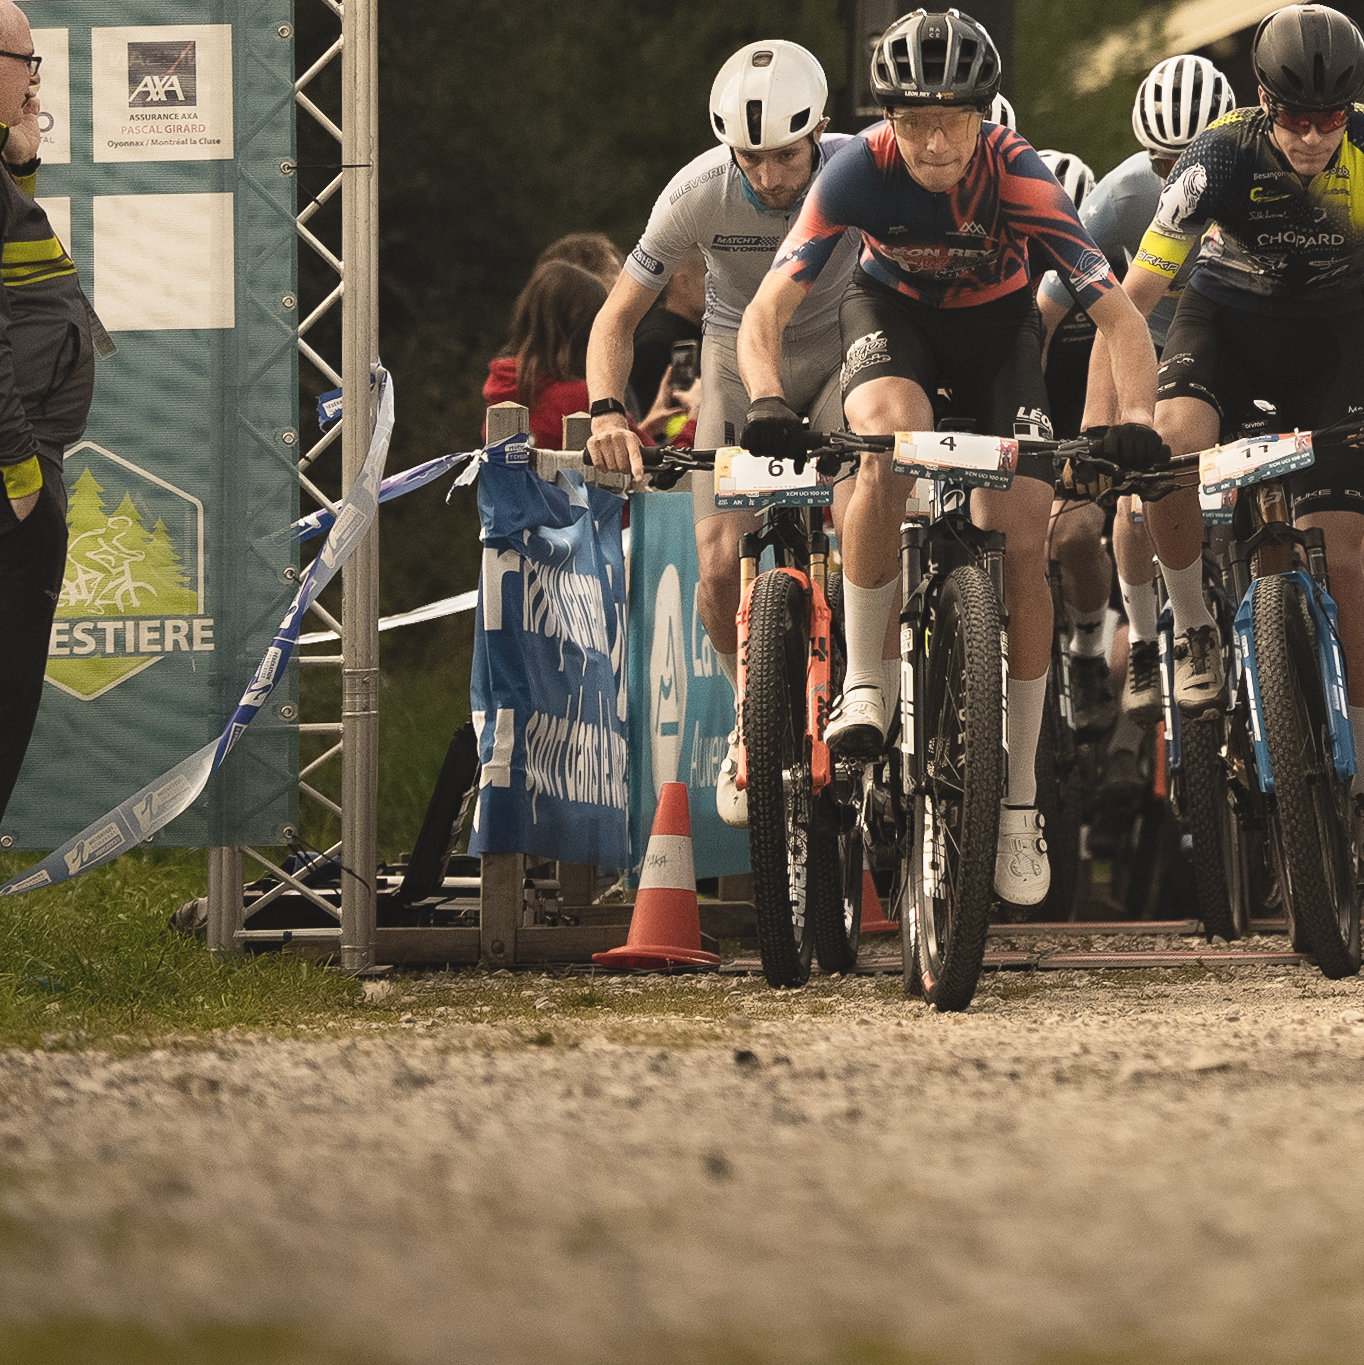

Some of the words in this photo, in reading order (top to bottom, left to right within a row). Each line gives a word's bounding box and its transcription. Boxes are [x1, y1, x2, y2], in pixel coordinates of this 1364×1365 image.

[129, 75, 186, 102] AXA
[129, 113, 179, 121] ASSURANCE
[181, 112, 198, 120] AXA
[121, 125, 162, 134] PASCAL
[164, 123, 206, 134] GIRARD
[107, 139, 145, 149] Oyonnax
[151, 137, 188, 147] Montréal
[199, 137, 221, 145] Cluse
[717, 236, 758, 245] MATCHY
[1257, 231, 1344, 247] CHOPARD
[1136, 248, 1180, 274] ÖRKA
[1017, 406, 1051, 427] LÉO
[939, 436, 957, 452] 4
[767, 459, 784, 478] 6
[48, 618, 215, 656] ESTIERE
